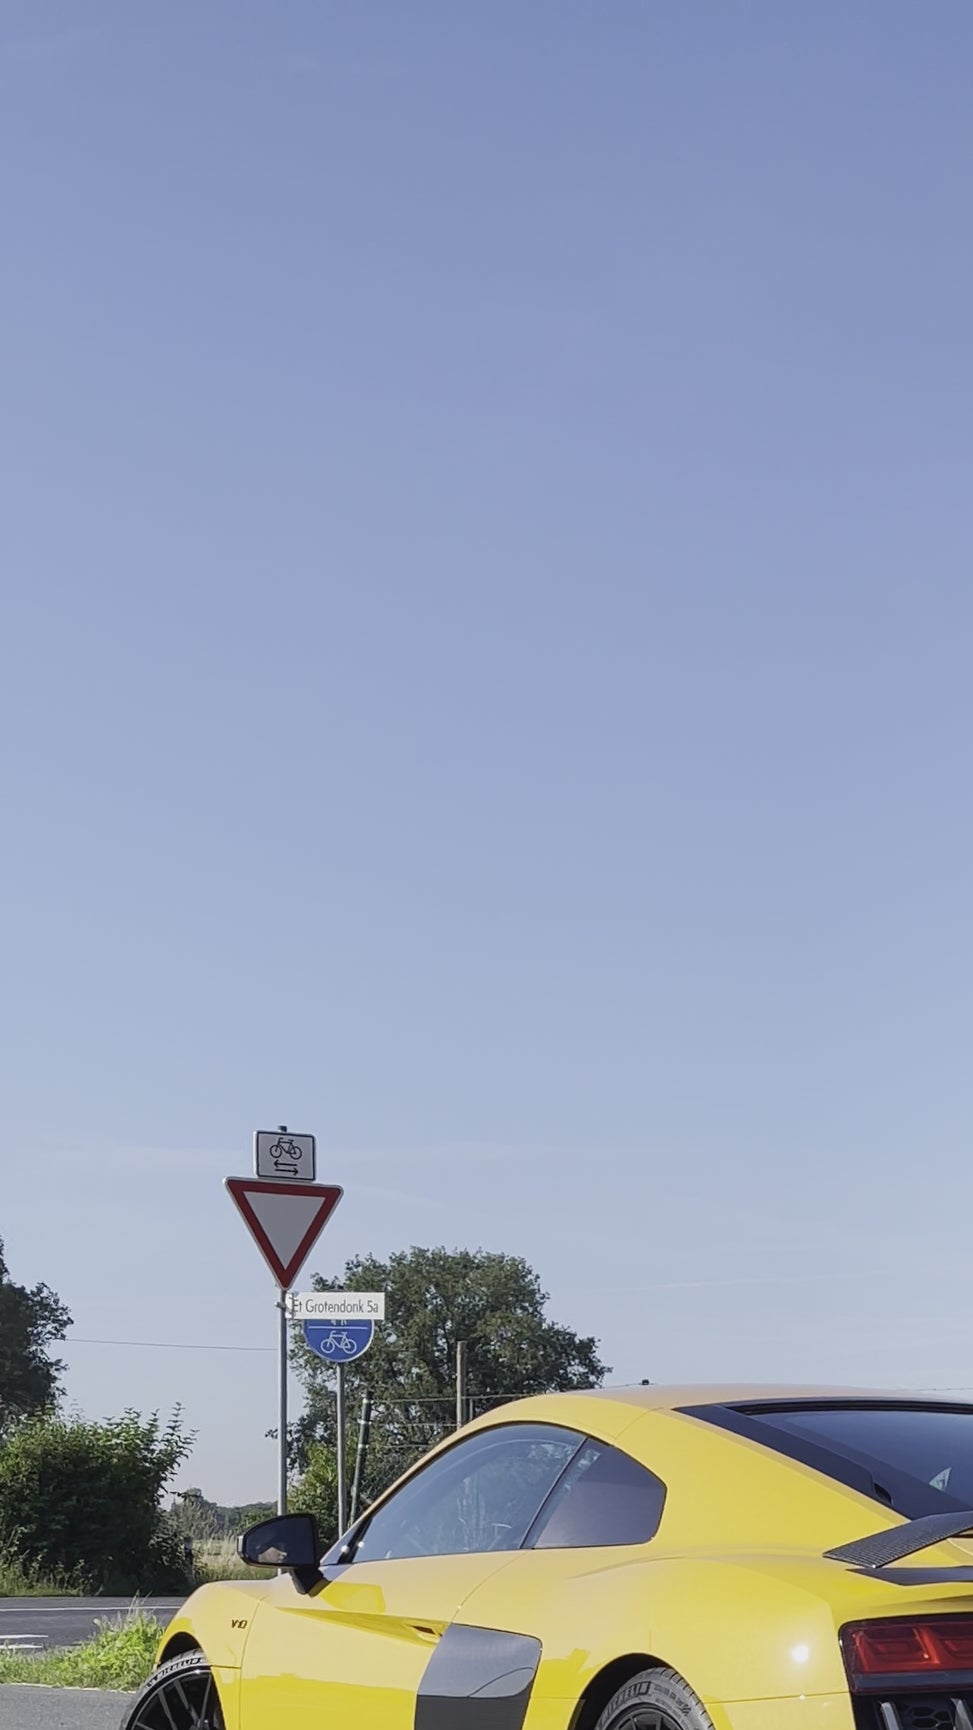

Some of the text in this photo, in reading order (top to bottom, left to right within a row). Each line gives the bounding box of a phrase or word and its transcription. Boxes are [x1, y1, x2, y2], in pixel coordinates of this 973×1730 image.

[305, 1299, 364, 1313] Grotendonk
[367, 1300, 379, 1313] 5a
[231, 1619, 248, 1629] V10
